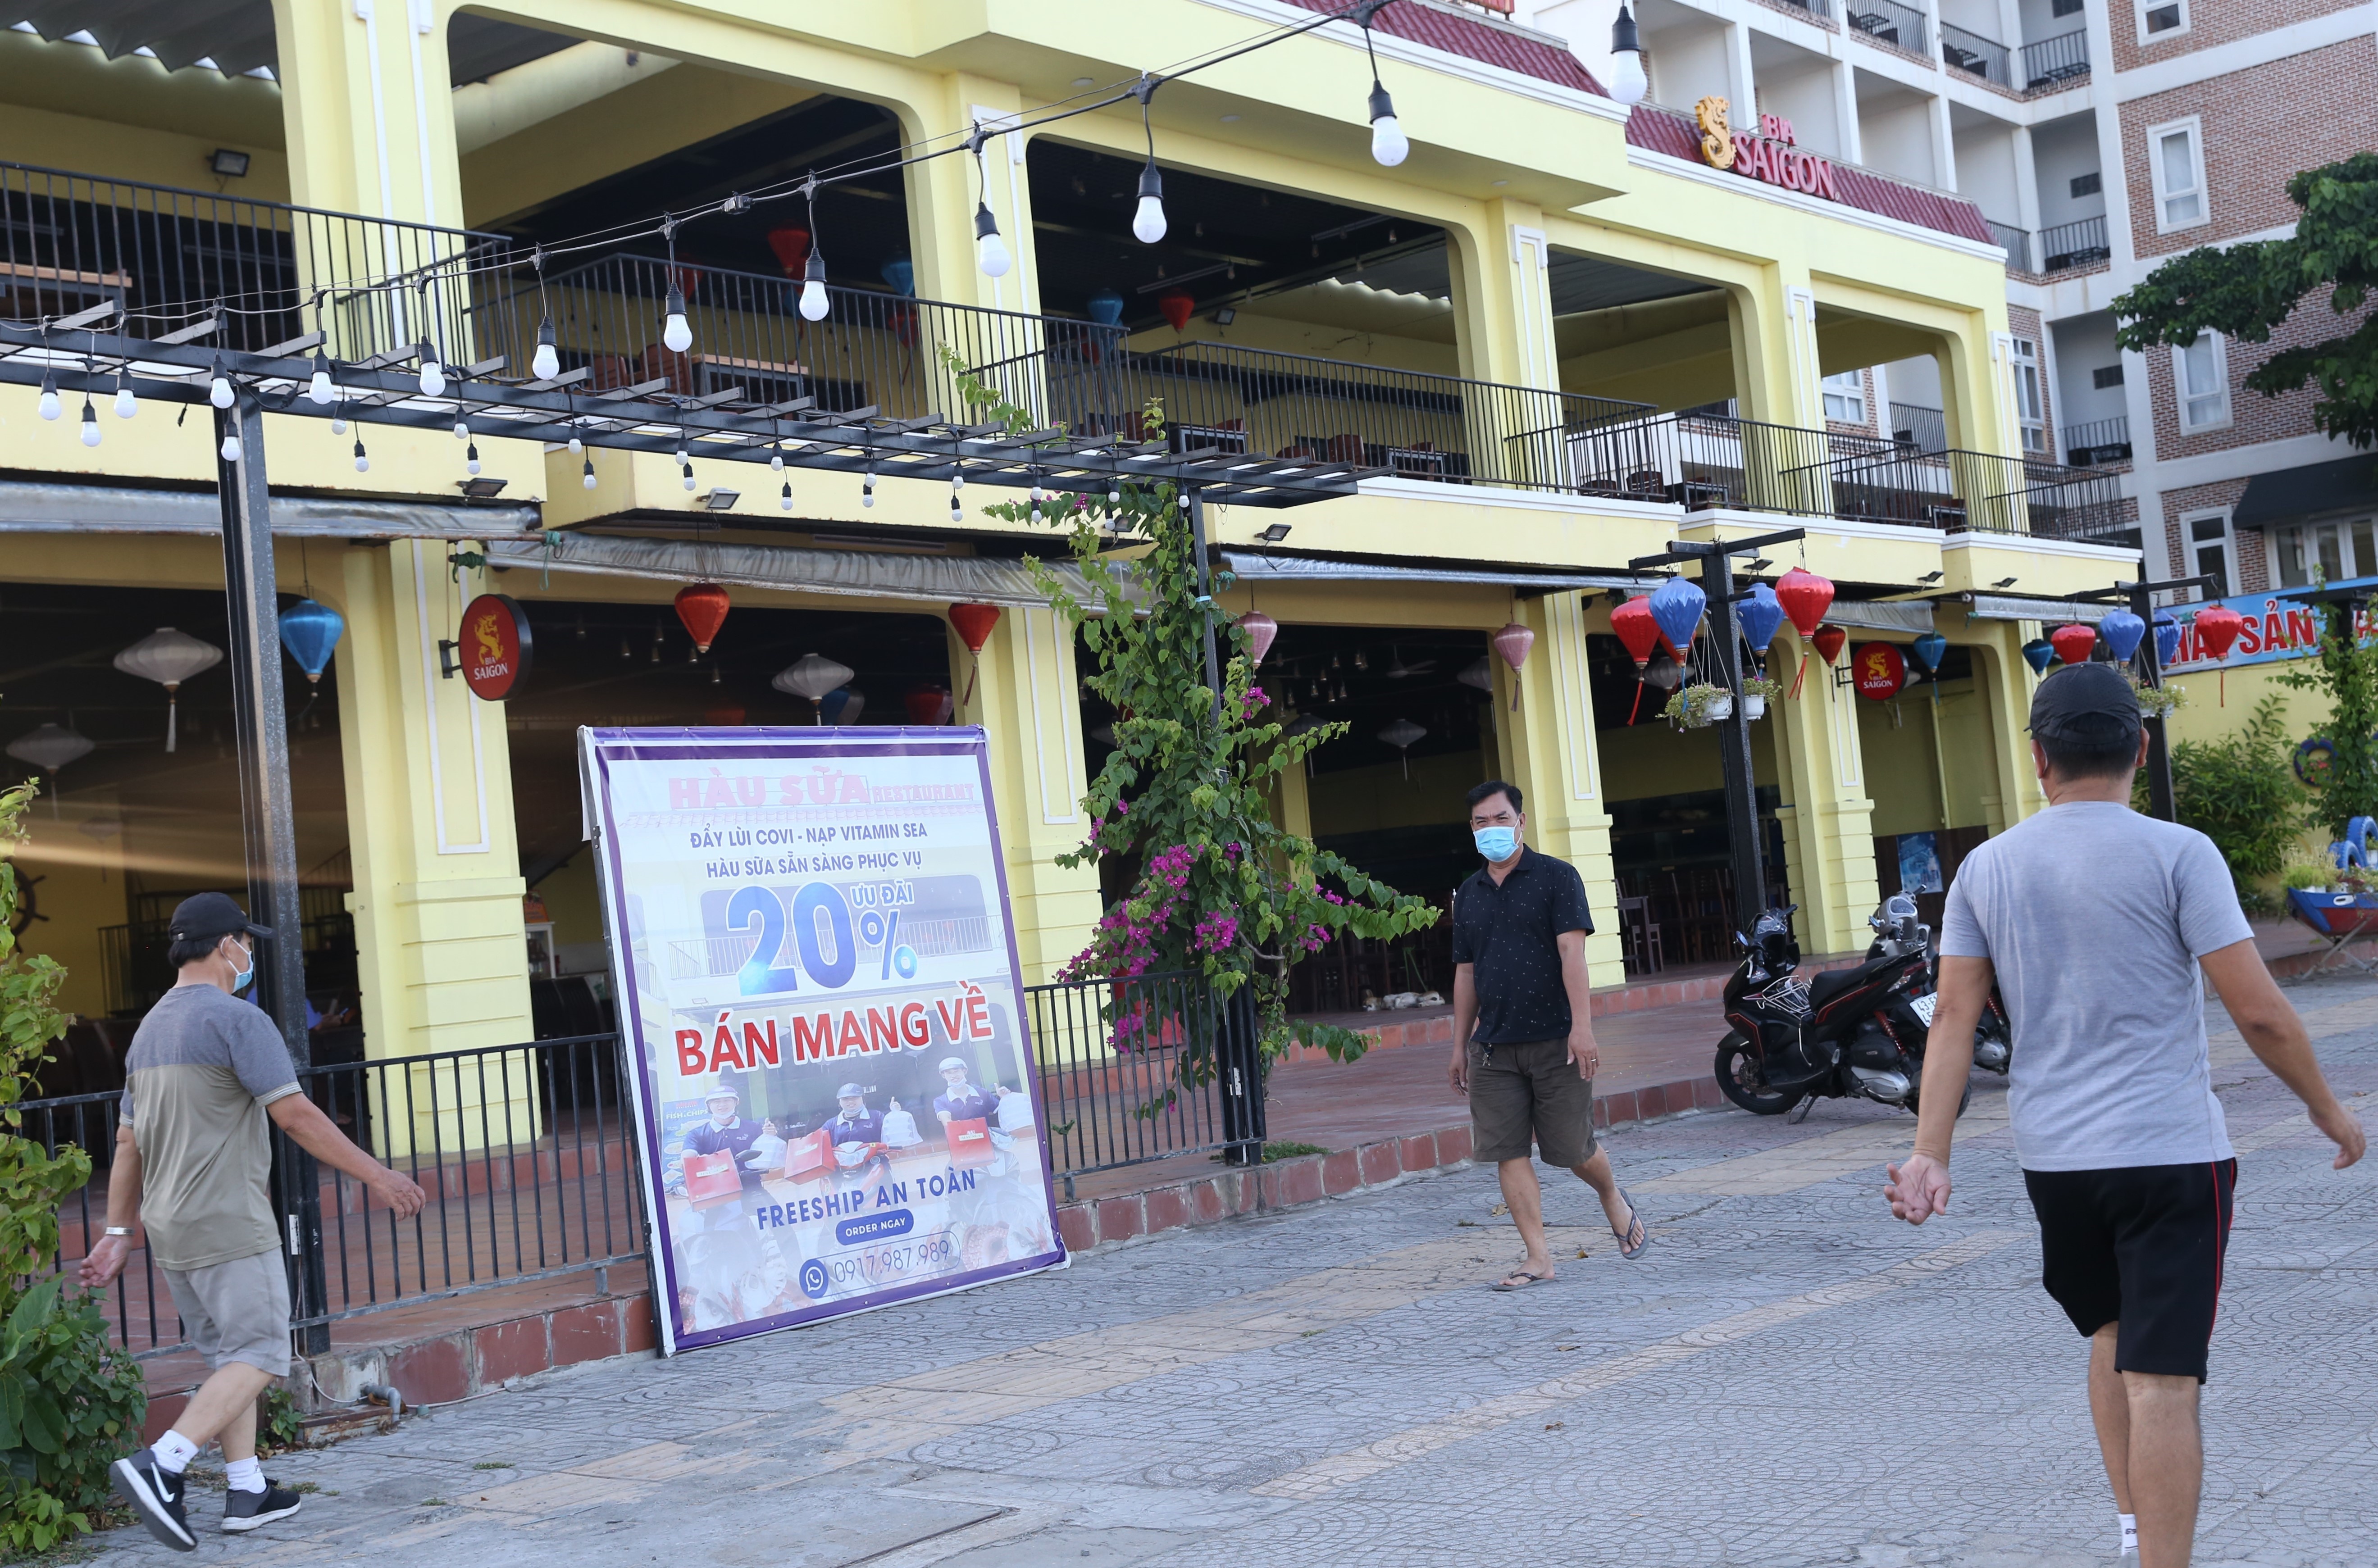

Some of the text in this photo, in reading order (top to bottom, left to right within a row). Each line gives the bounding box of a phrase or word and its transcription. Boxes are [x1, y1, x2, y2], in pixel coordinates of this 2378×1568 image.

[1762, 114, 1797, 145] BIA
[1733, 131, 1835, 201] SAIGON
[2239, 600, 2315, 654] SẢN
[474, 663, 508, 680] SAIGON
[1863, 680, 1893, 689] SAIGON
[669, 765, 974, 809] HÀU SỮA RESTAURANT
[690, 823, 722, 848] ĐẨY
[729, 827, 751, 847] LÙI
[756, 829, 794, 845] COVI
[806, 827, 836, 847] NẠP
[840, 824, 900, 841] VITAMIN
[903, 823, 928, 838] SEA
[706, 851, 922, 878] HÀU SỮA SẴN SÀNG PHỤC VỤ
[851, 881, 914, 905] ƯU ĐÃI
[675, 980, 992, 1076] BÁN MANG VỀ
[666, 1111, 683, 1119] FISH
[757, 1166, 975, 1230] FREESHIP AN TOÀN
[845, 1217, 906, 1237] ORDER NGAY
[834, 1240, 949, 1283] 0917.987.989
